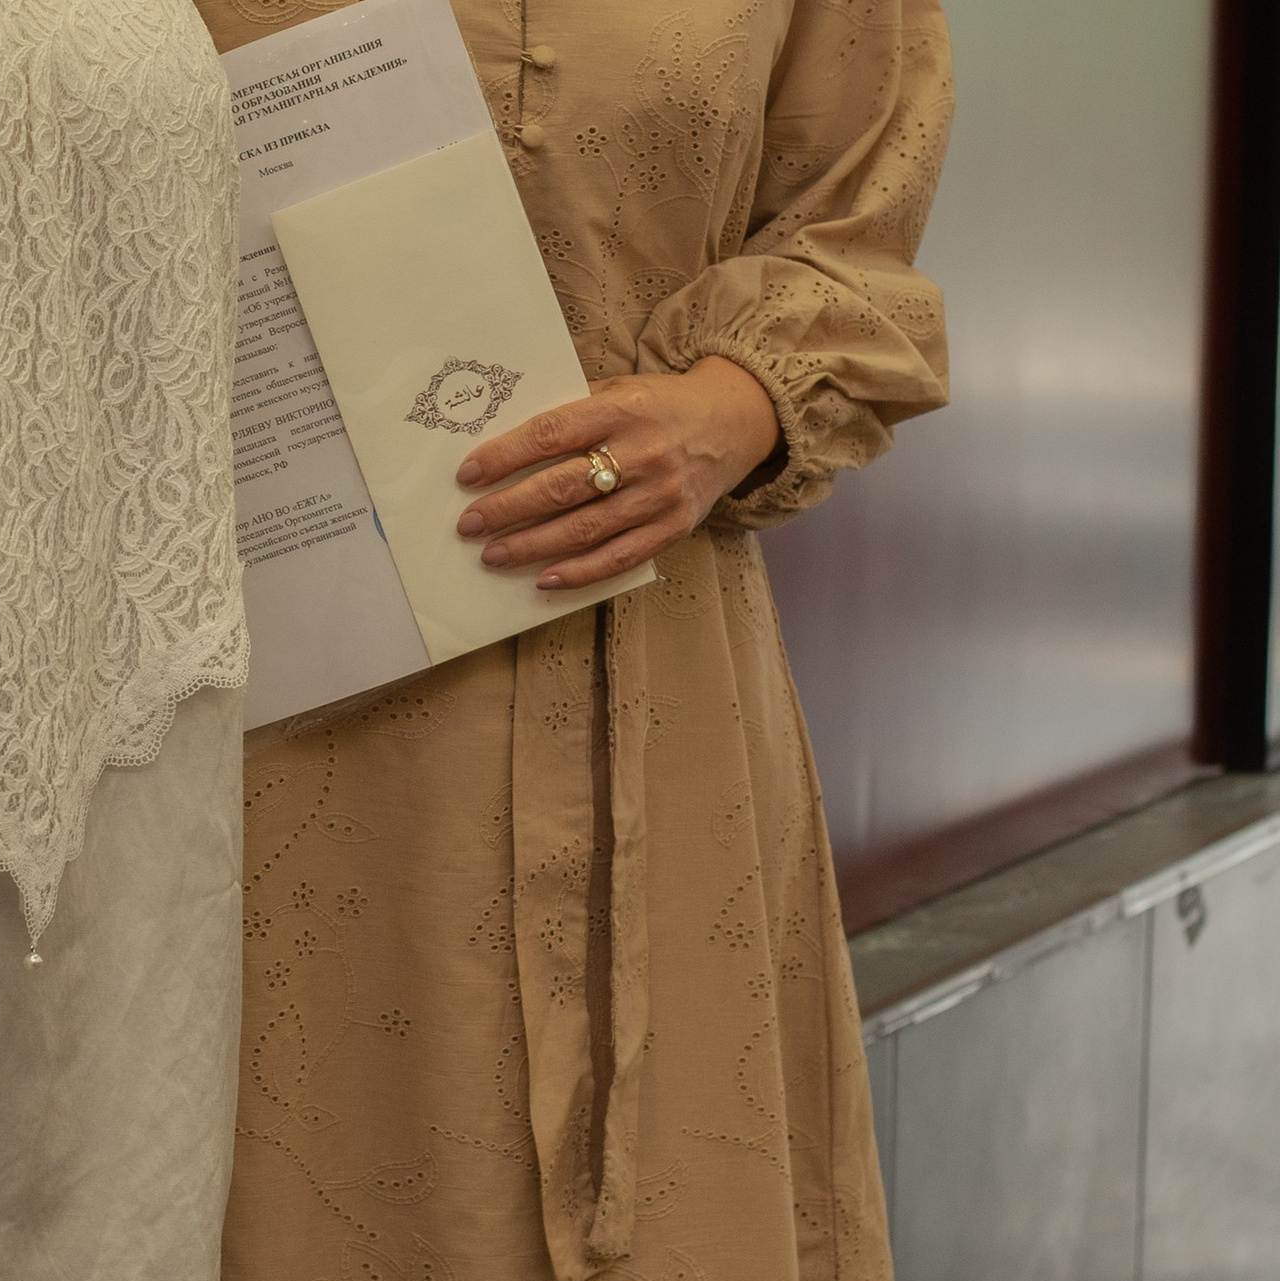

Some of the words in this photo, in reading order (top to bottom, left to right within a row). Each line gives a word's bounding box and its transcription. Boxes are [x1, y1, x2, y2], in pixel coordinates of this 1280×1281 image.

[231, 69, 300, 101] МЕРЧЕСКАЯ
[301, 38, 383, 75] ОРГАНИЗАЦИЯ
[241, 74, 322, 111] ОБРАЗОВАНИЯ
[247, 81, 339, 121] ГУМАНИТАРНАЯ
[342, 57, 408, 87] АКАДЕМИЯ»
[238, 147, 262, 162] СКА
[263, 140, 279, 153] ИЗ
[279, 122, 331, 147] ПРИКАЗА
[258, 160, 294, 178] Москва
[239, 244, 276, 262] ждении
[264, 290, 298, 310] учрежд
[238, 306, 298, 334] утверждении
[231, 388, 262, 404] тепень
[265, 365, 324, 391] общественно
[255, 390, 298, 410] женского
[231, 419, 271, 441] РЛЯЕВУ
[274, 399, 335, 426] ВИКТОРИЮ
[287, 426, 347, 452] государствен
[273, 460, 289, 472] РФ
[235, 521, 250, 532] тор
[251, 511, 274, 526] АНО
[274, 505, 291, 518] ВО
[236, 523, 284, 544] едседатель
[284, 502, 343, 527] Оргкомитета
[299, 521, 329, 536] съезда
[329, 506, 369, 525] женских
[301, 522, 357, 548] организаций
